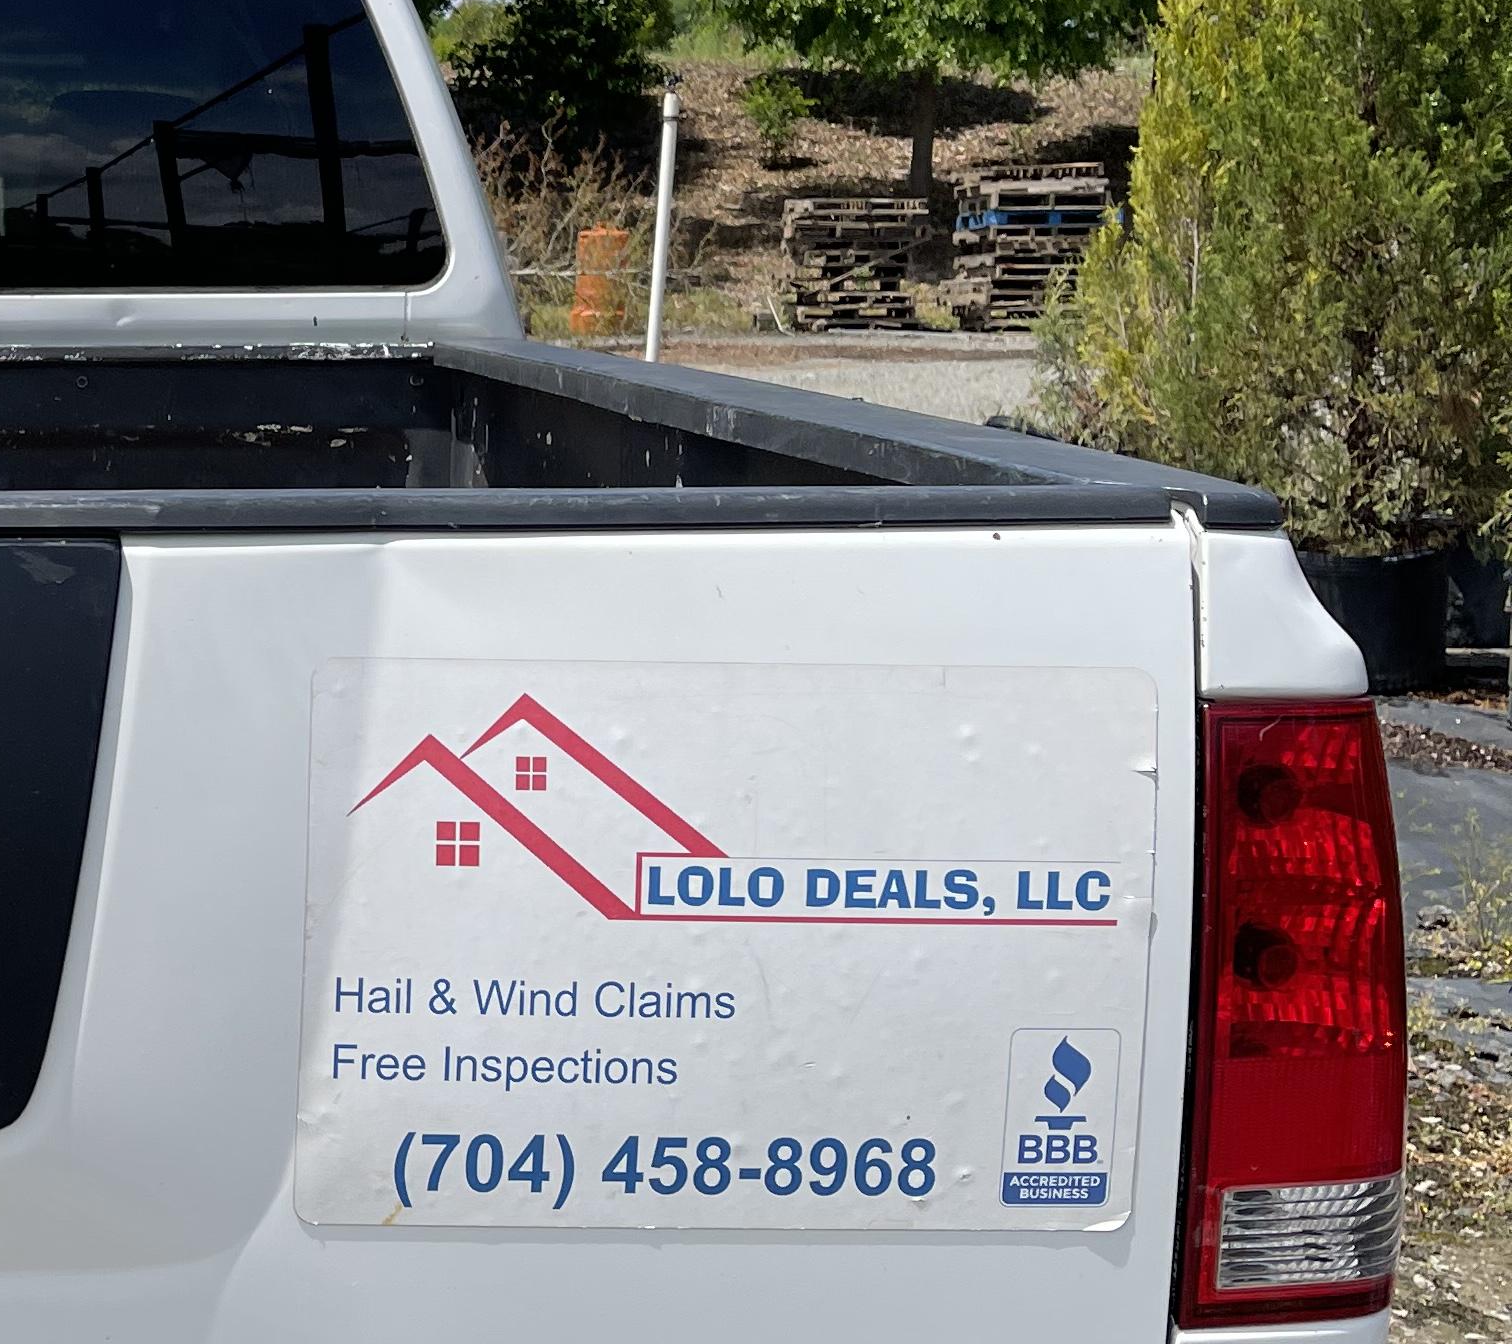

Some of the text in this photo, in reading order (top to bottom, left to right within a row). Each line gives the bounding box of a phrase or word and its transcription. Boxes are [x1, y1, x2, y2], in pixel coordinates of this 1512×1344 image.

[648, 865, 1112, 917] LOLO DEALS, LLC
[334, 978, 736, 1021] Hail & Wind Claims
[332, 1043, 678, 1090] Free Inspections
[393, 1131, 938, 1211] (704) 458-8968
[1017, 1134, 1098, 1165] BBB
[1009, 1175, 1101, 1188] ACCREDITED
[1019, 1187, 1089, 1200] BUSINESS
